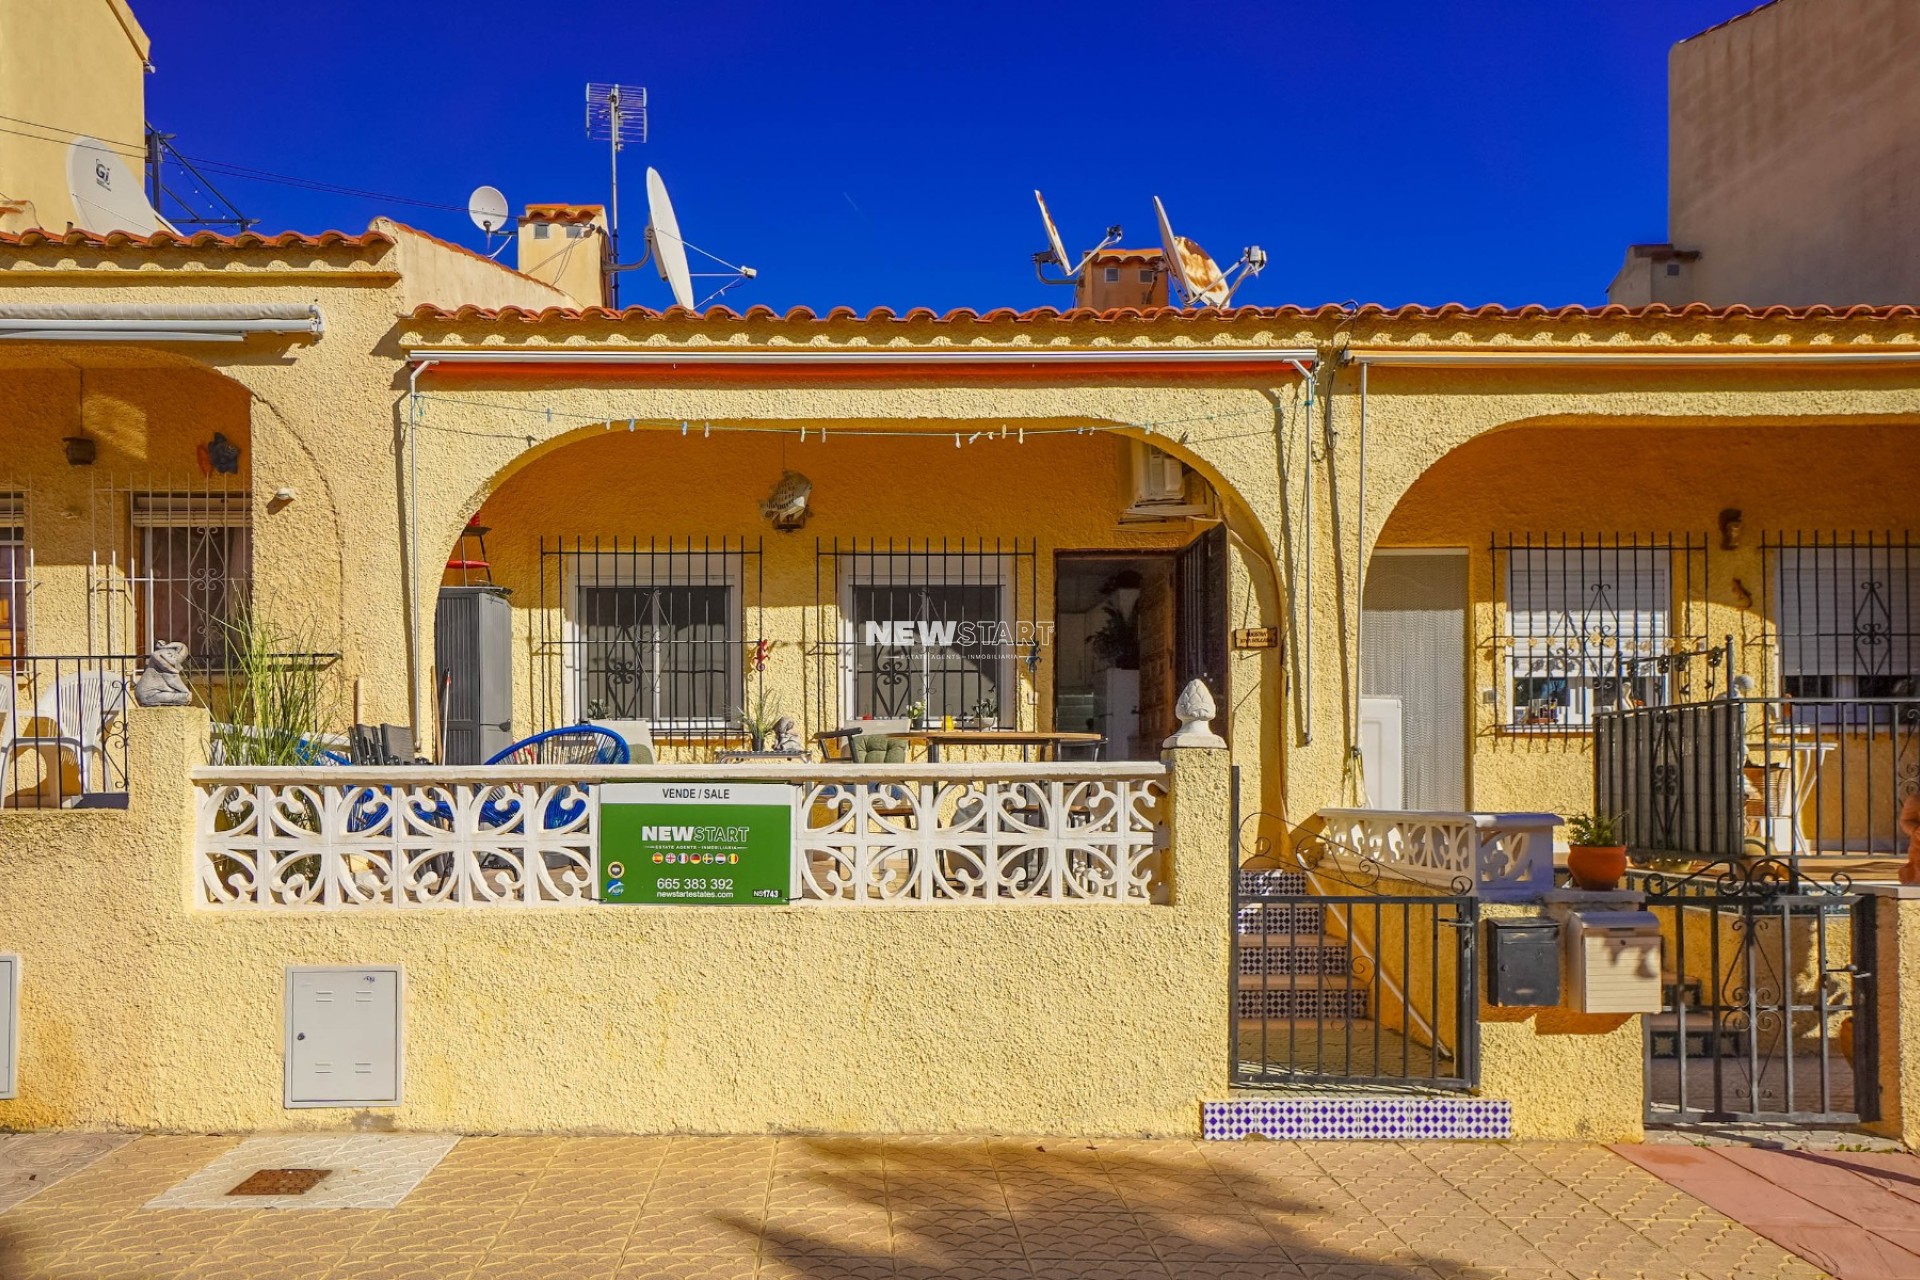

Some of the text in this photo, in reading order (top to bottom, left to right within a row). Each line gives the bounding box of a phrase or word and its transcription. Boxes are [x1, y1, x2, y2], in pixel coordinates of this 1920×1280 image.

[662, 788, 696, 799] VENDE
[704, 788, 730, 799] SALE
[641, 826, 750, 843] NEWSTART
[656, 878, 734, 890] 665 383 392
[656, 890, 734, 898] newstartestates.com
